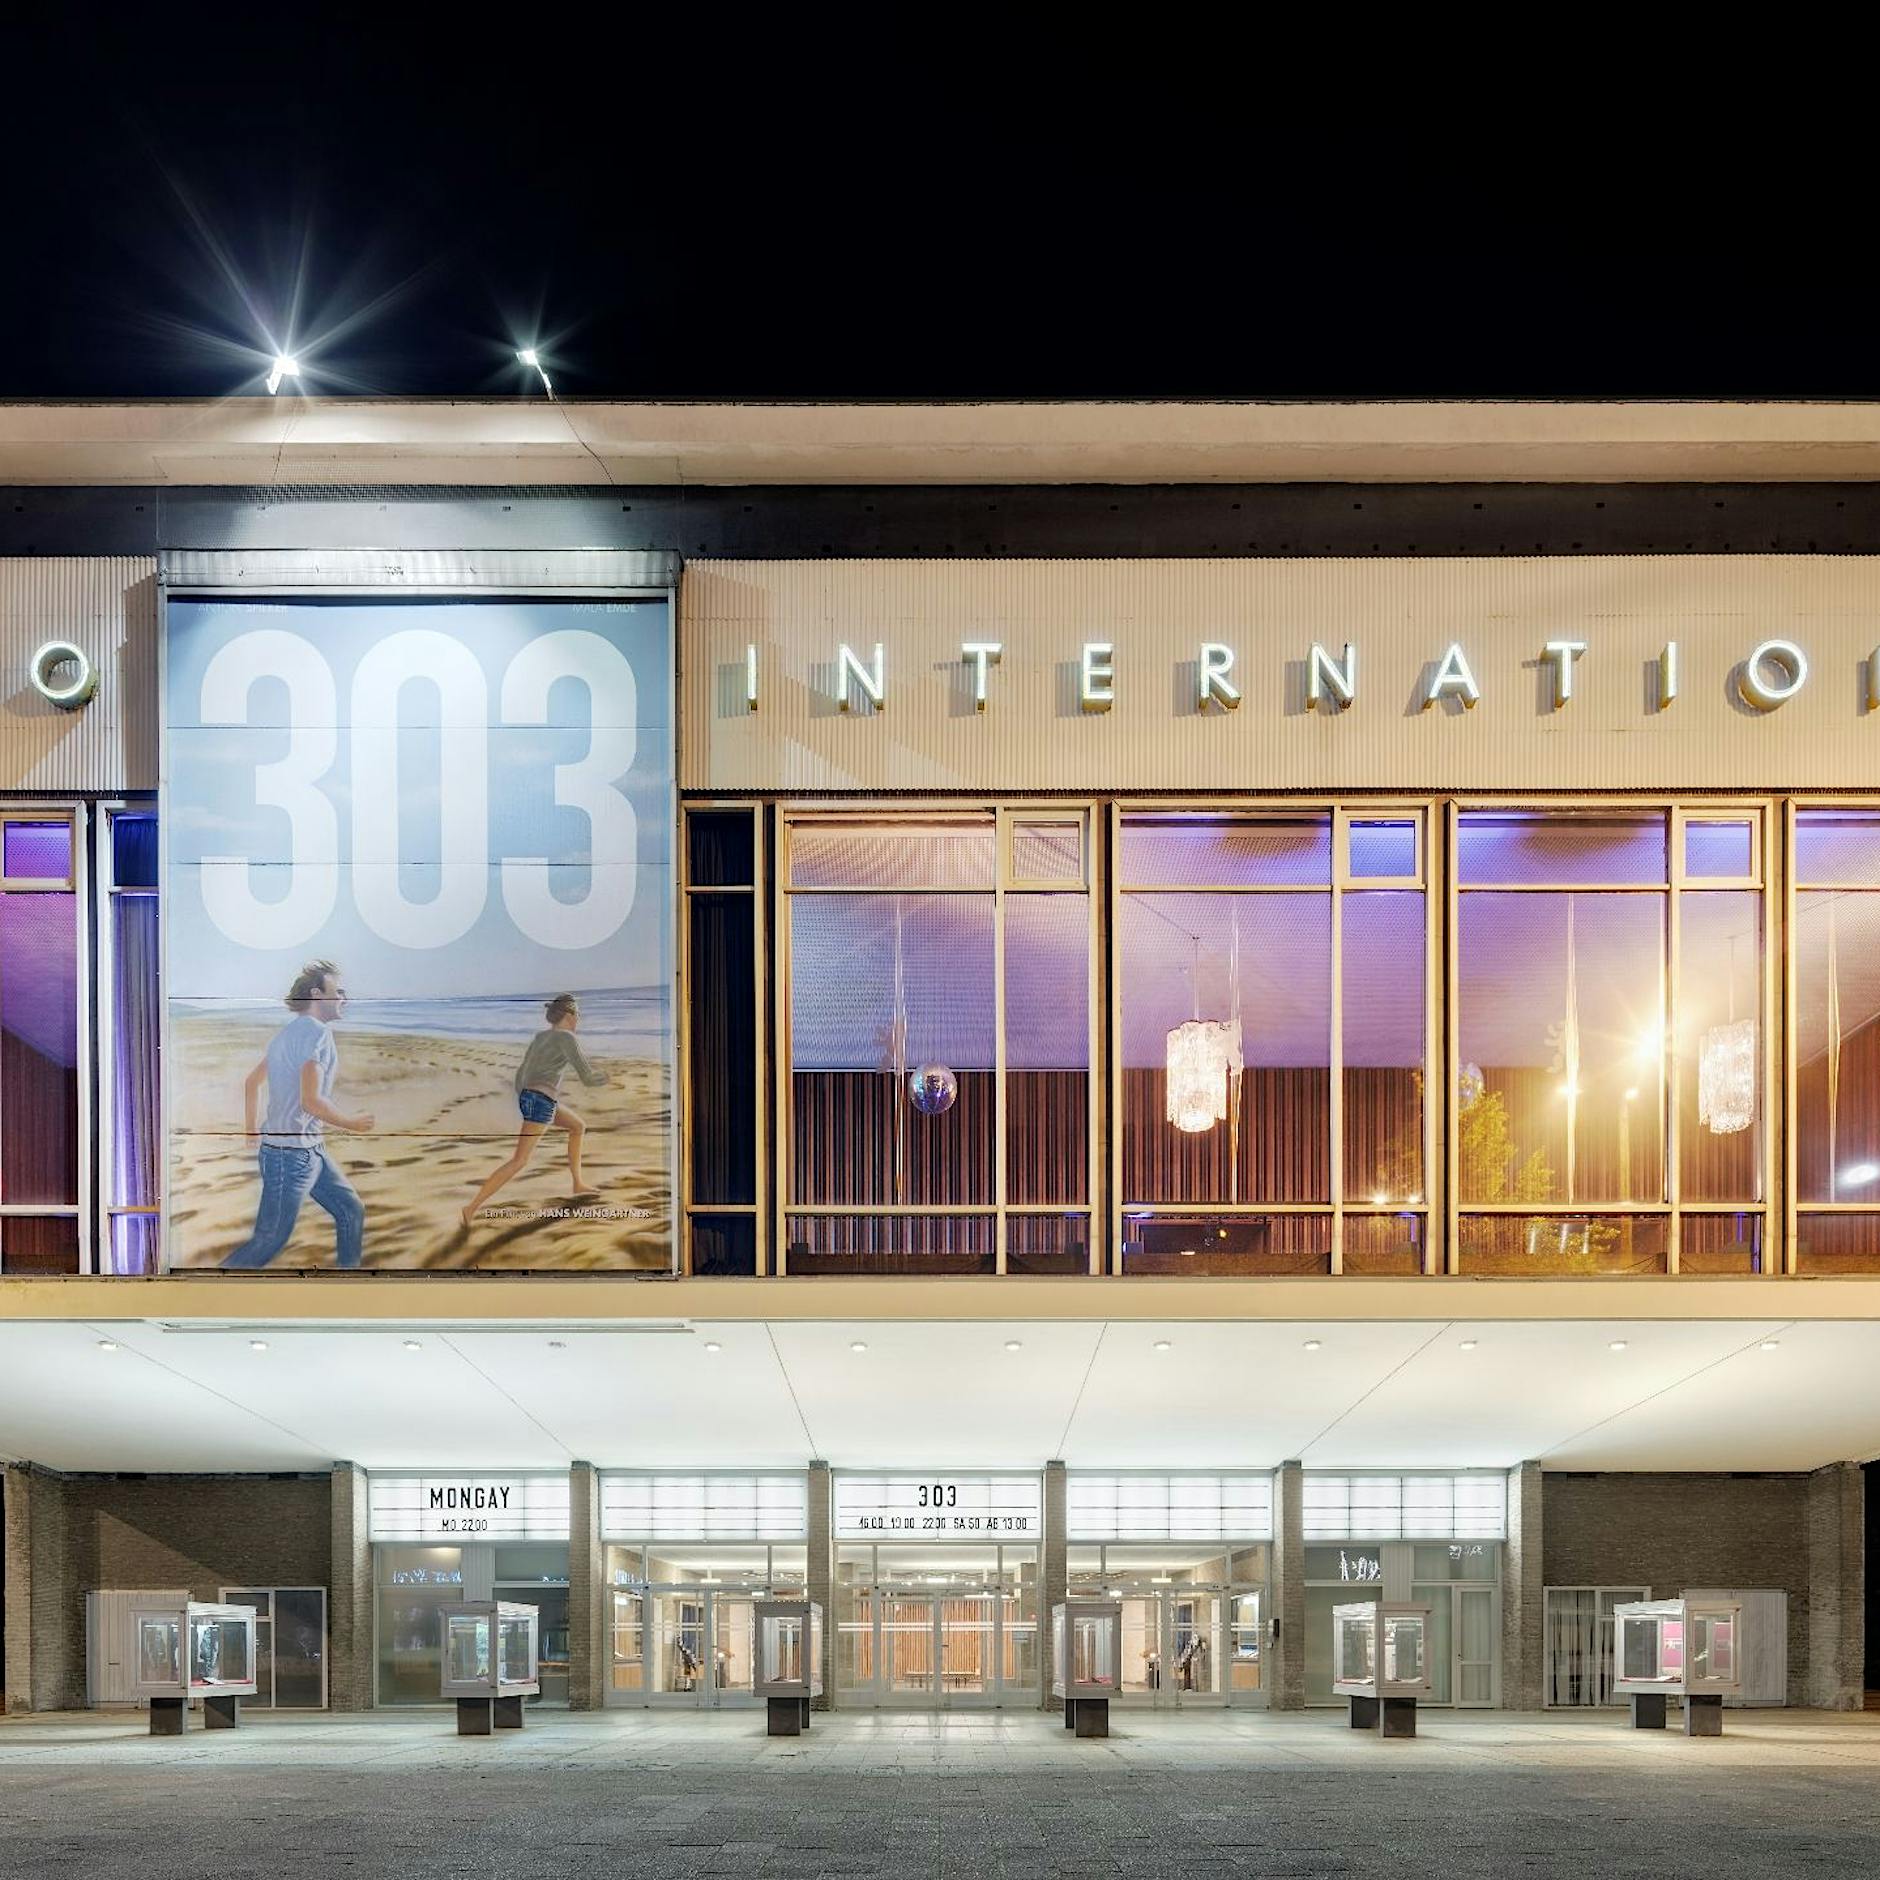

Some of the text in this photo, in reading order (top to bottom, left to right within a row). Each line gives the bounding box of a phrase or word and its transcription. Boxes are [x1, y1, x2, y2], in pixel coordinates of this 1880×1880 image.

[747, 639, 1880, 710] INTERNATIO
[200, 629, 638, 951] 303
[538, 1207, 571, 1218] HANS
[572, 1207, 651, 1218] WEINGARTNER
[430, 1486, 511, 1509] MONGAY
[918, 1484, 957, 1507] 303
[442, 1518, 457, 1531] MO
